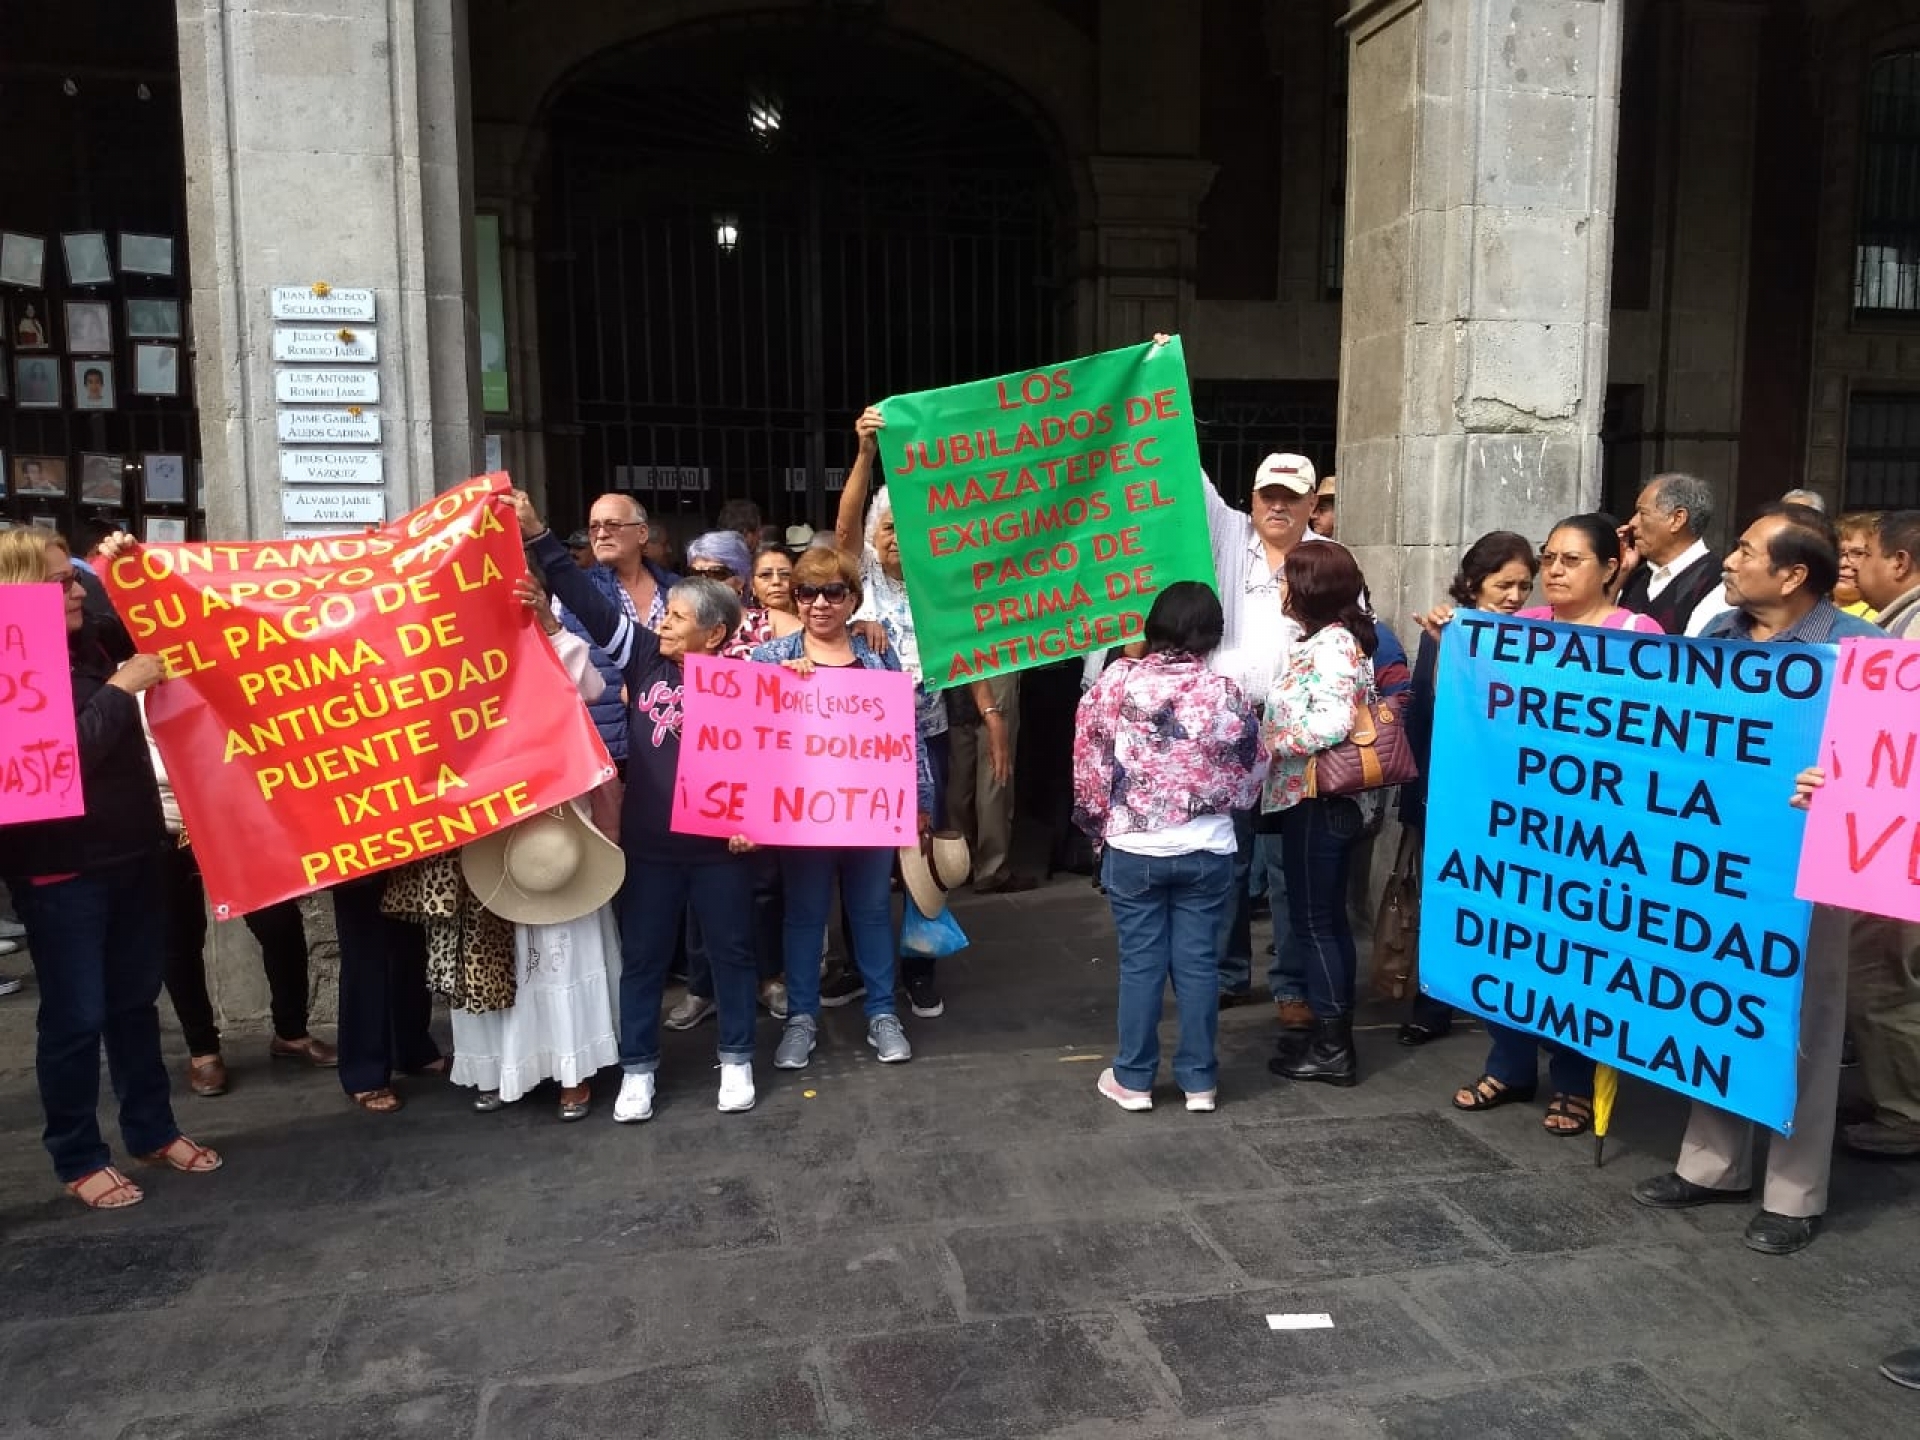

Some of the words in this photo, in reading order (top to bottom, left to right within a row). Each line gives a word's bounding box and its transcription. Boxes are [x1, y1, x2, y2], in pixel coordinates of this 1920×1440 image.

[279, 290, 305, 301] JUAN
[308, 290, 367, 301] FNCISCO
[320, 305, 363, 315] ORTEGA
[287, 345, 332, 355] ROMERO
[335, 345, 366, 357] JAIME
[290, 373, 313, 383] LUIS
[316, 373, 366, 383] ANTONIO
[996, 369, 1074, 412] LOS
[290, 386, 334, 397] ROMERO
[336, 386, 367, 398] JAIME
[291, 413, 321, 425] JAIME
[323, 413, 367, 424] GABRIEL
[895, 404, 1115, 475] JUBILADOS
[1124, 388, 1180, 427] DE
[341, 495, 371, 506] JAIME
[927, 437, 1162, 515] MAZATEPEC
[111, 538, 393, 590] CONTAMOS
[412, 480, 493, 531] CON
[927, 491, 1111, 558] EXIGIMOS
[1123, 479, 1176, 513] EL
[128, 599, 186, 637] SU
[203, 567, 374, 617] APOYO
[393, 505, 504, 570] PARA
[972, 542, 1080, 591] PAGO
[1092, 526, 1145, 562] DE
[162, 639, 216, 680] EL
[223, 598, 355, 659] PAGO
[374, 574, 440, 614] DE
[457, 559, 503, 593] LA
[972, 581, 1093, 633] PRIMA
[1105, 565, 1158, 601] DE
[238, 639, 384, 705] PRIMA
[397, 612, 465, 657] DE
[695, 666, 742, 698] LOS
[1461, 619, 1823, 700] TEPALCINGO
[223, 648, 508, 763] ANTIGÜEDAD
[697, 724, 742, 751] NO
[753, 726, 792, 750] TE
[1487, 682, 1775, 767] PRESENTE
[256, 720, 438, 800] PUENTE
[450, 696, 508, 741] DE
[1517, 746, 1624, 806] POR
[1647, 770, 1722, 827] LA
[301, 781, 538, 886] PRESENTE
[335, 765, 469, 827] IXTLA
[773, 786, 905, 834] NOTA!
[1489, 799, 1648, 876] PRIMA
[1671, 842, 1752, 900] DE
[1437, 848, 1800, 979] ANTIGÜEDAD
[1455, 908, 1767, 1041] DIPUTADOS
[1471, 973, 1733, 1098] CUMPLAN
